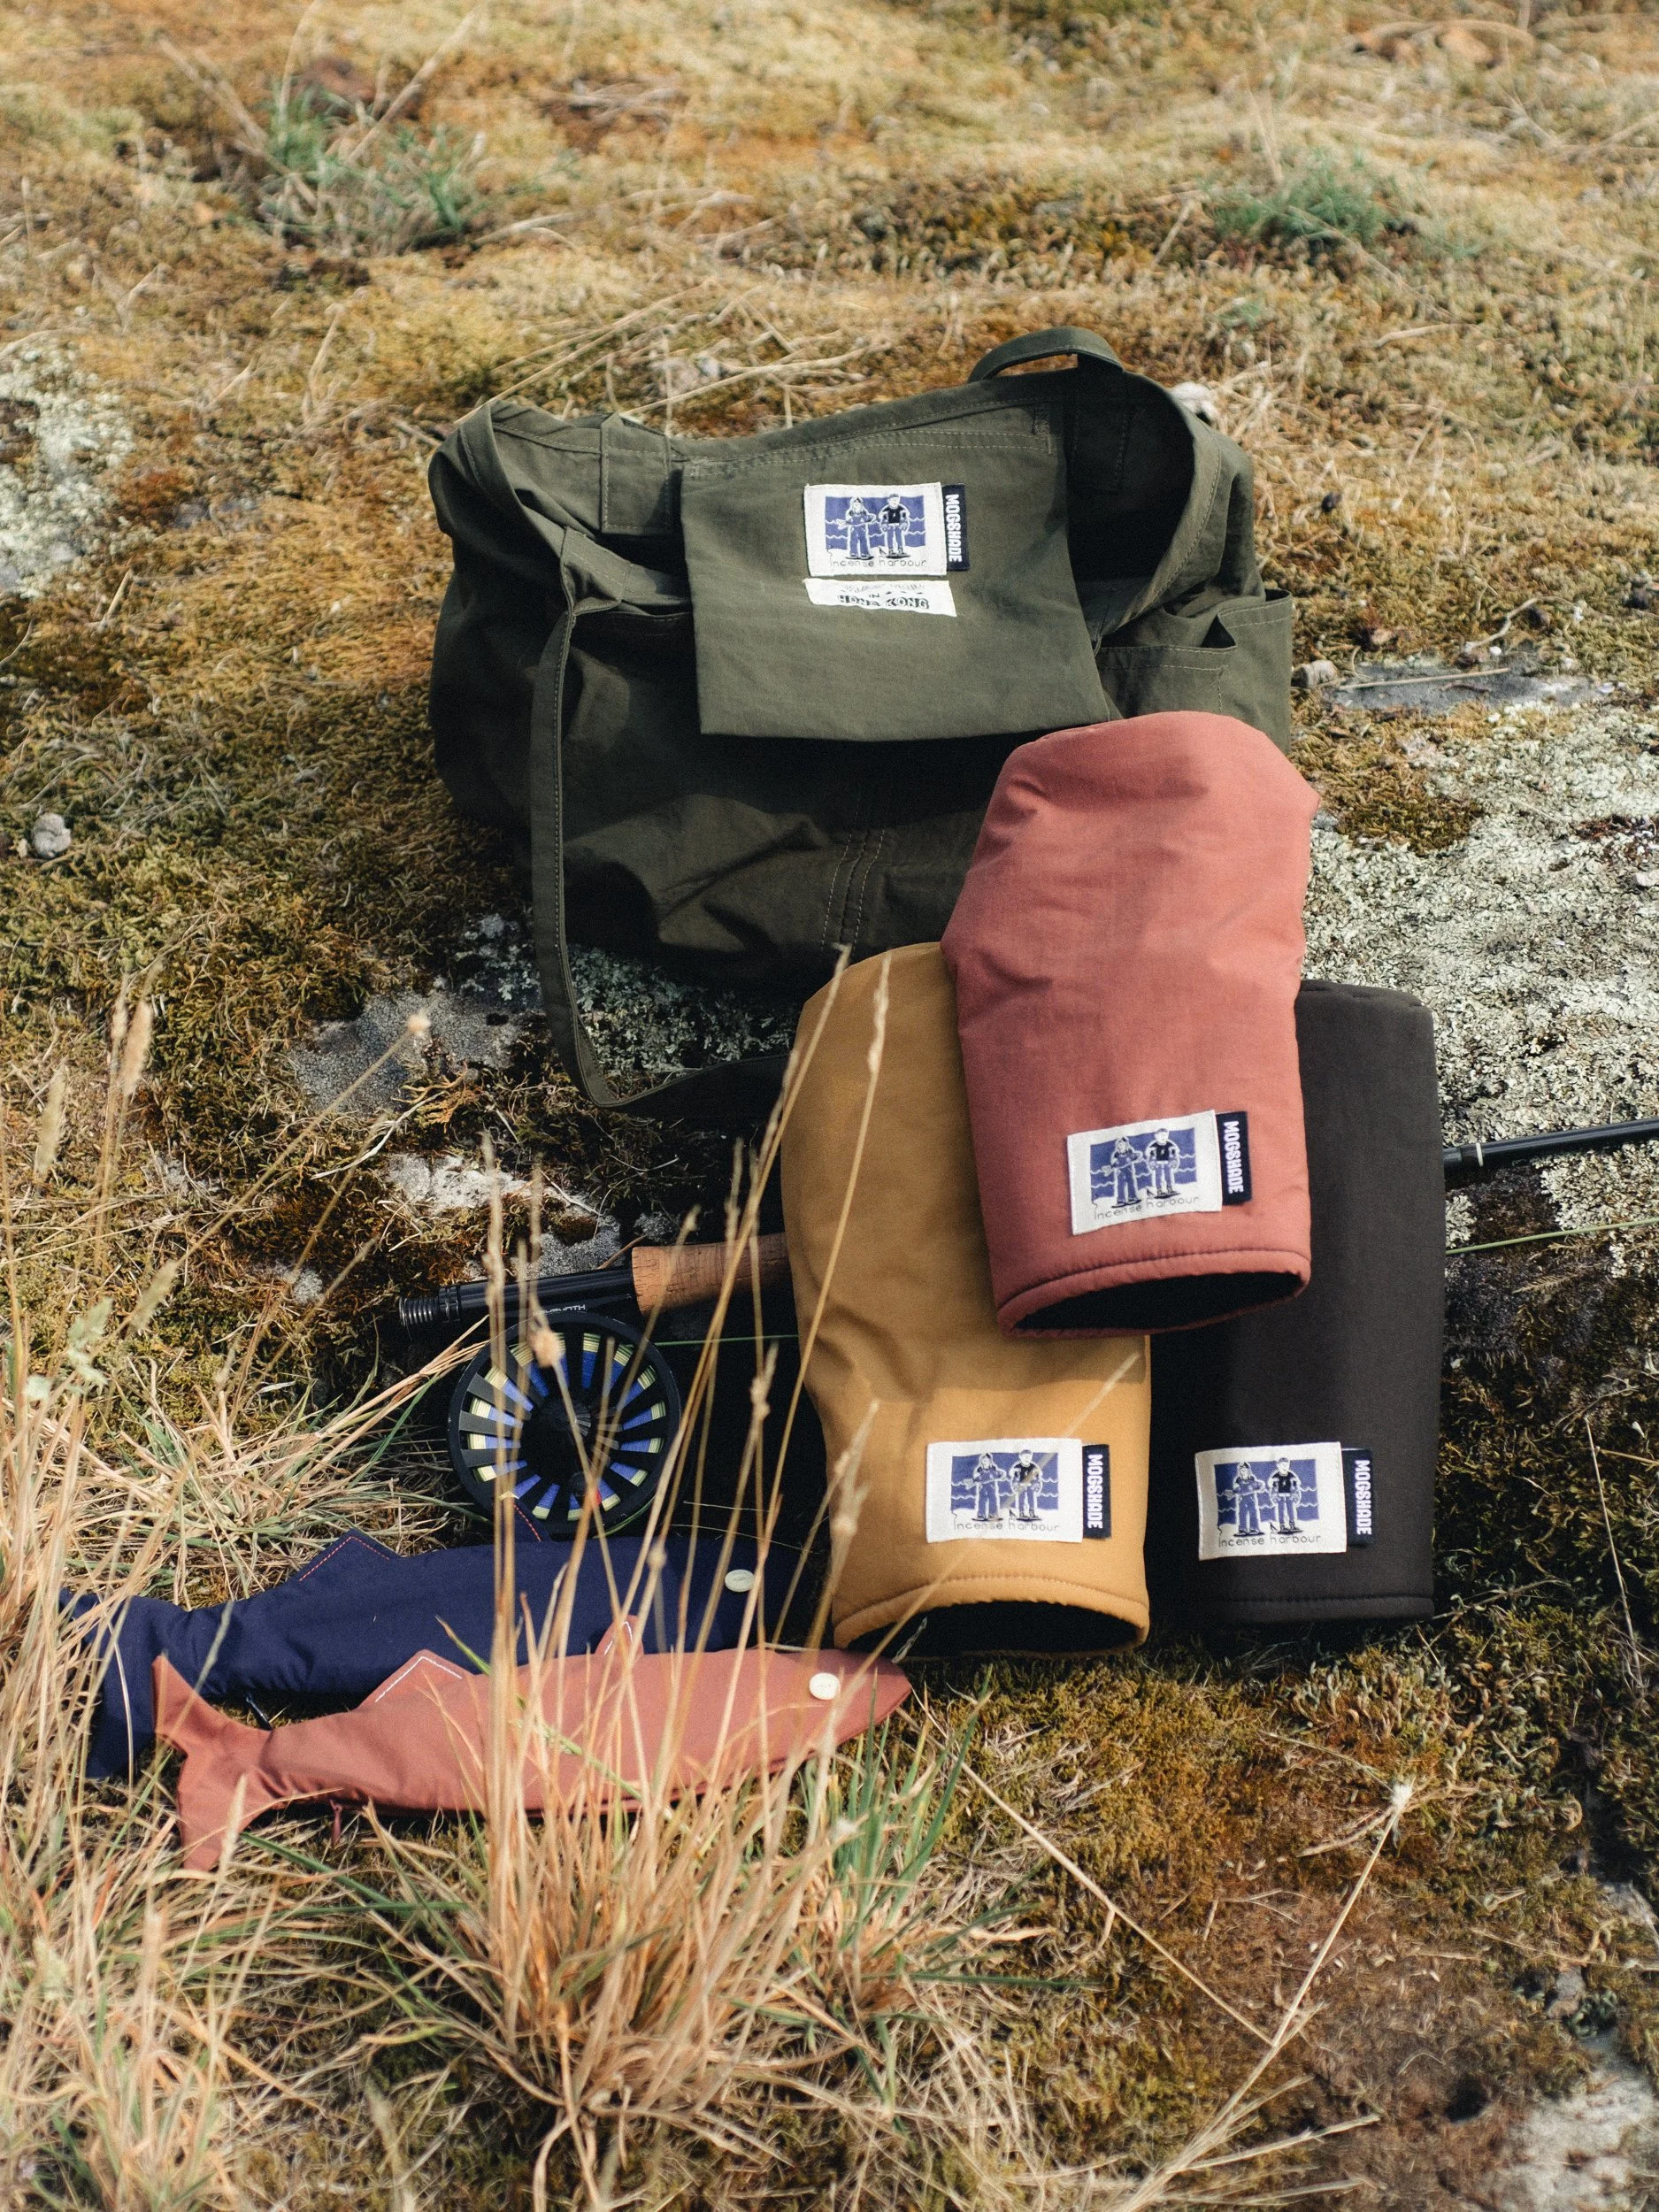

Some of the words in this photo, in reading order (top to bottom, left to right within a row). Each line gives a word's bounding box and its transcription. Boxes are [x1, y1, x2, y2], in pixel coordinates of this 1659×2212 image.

[945, 494, 963, 563] MOGSHADE
[886, 595, 930, 610] KONG
[1223, 1120, 1245, 1194] MOGSHADE
[1087, 1454, 1104, 1529] MOGSHADE
[1354, 1460, 1372, 1535] MOGSHADE
